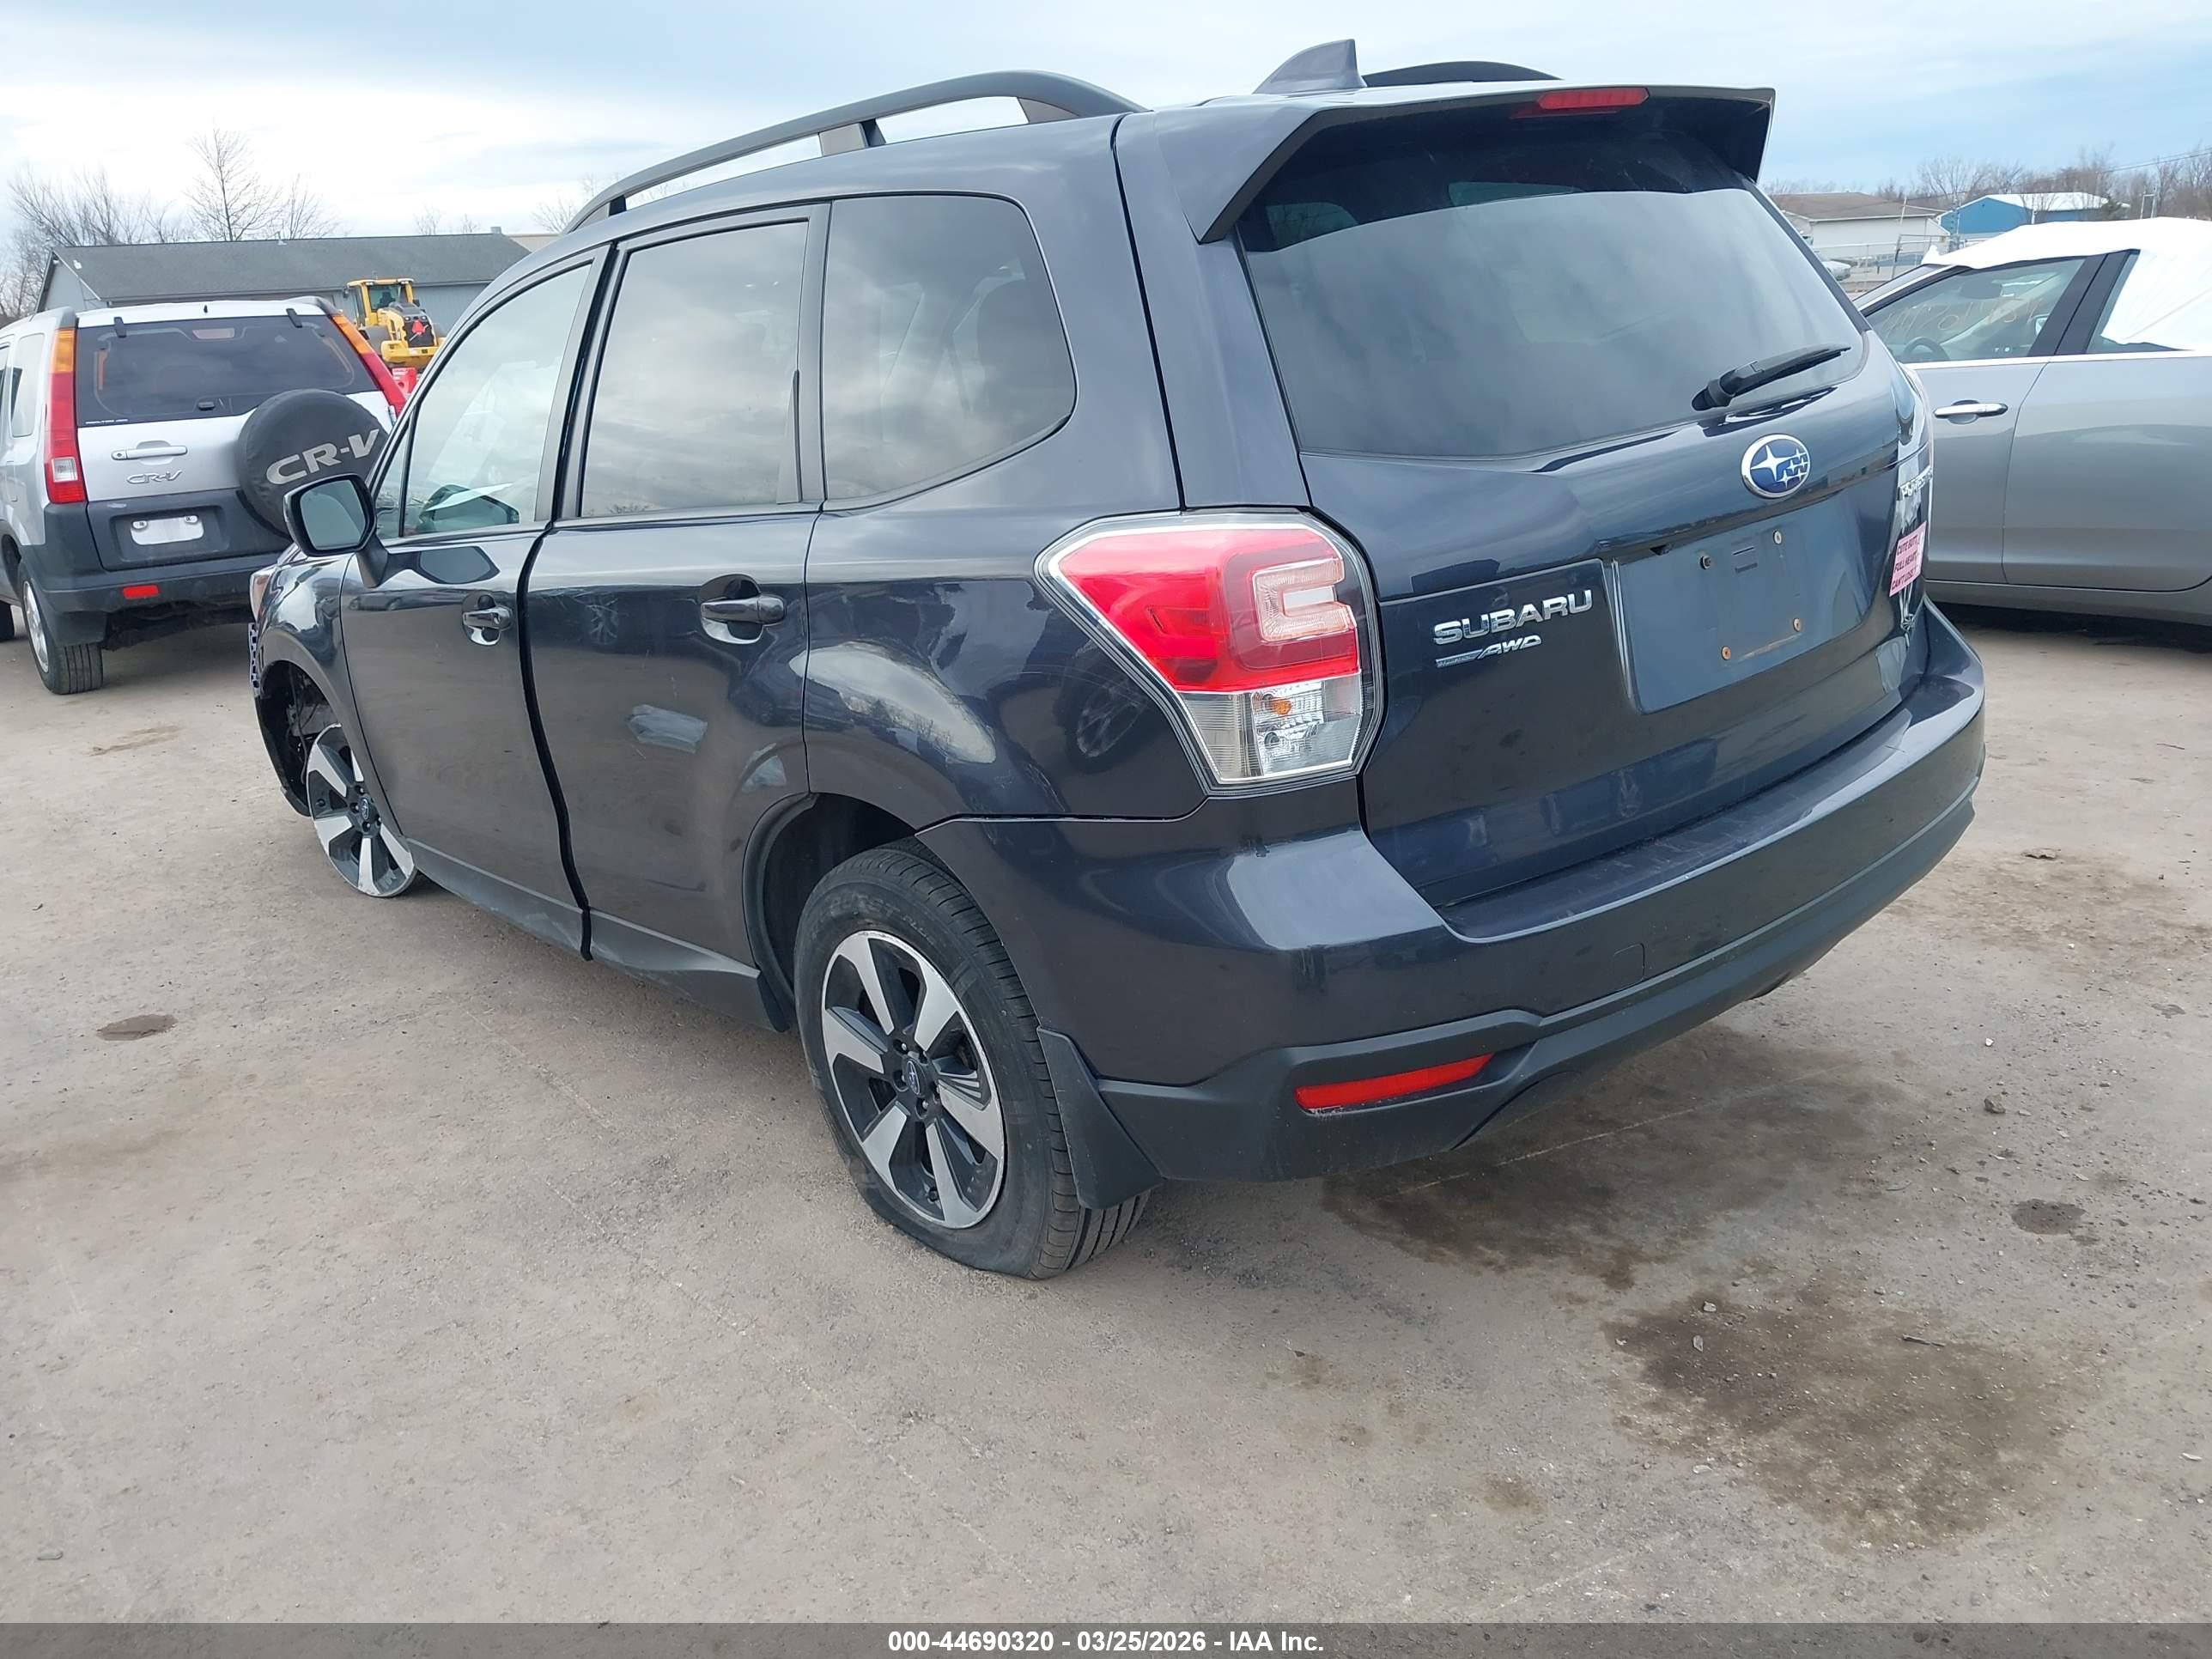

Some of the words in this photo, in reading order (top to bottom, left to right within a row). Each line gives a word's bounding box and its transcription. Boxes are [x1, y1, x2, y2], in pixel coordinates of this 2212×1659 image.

[266, 428, 380, 485] CR-V
[126, 469, 182, 485] CR-V
[1434, 590, 1593, 645] SUBARU
[1478, 635, 1542, 659] AWD
